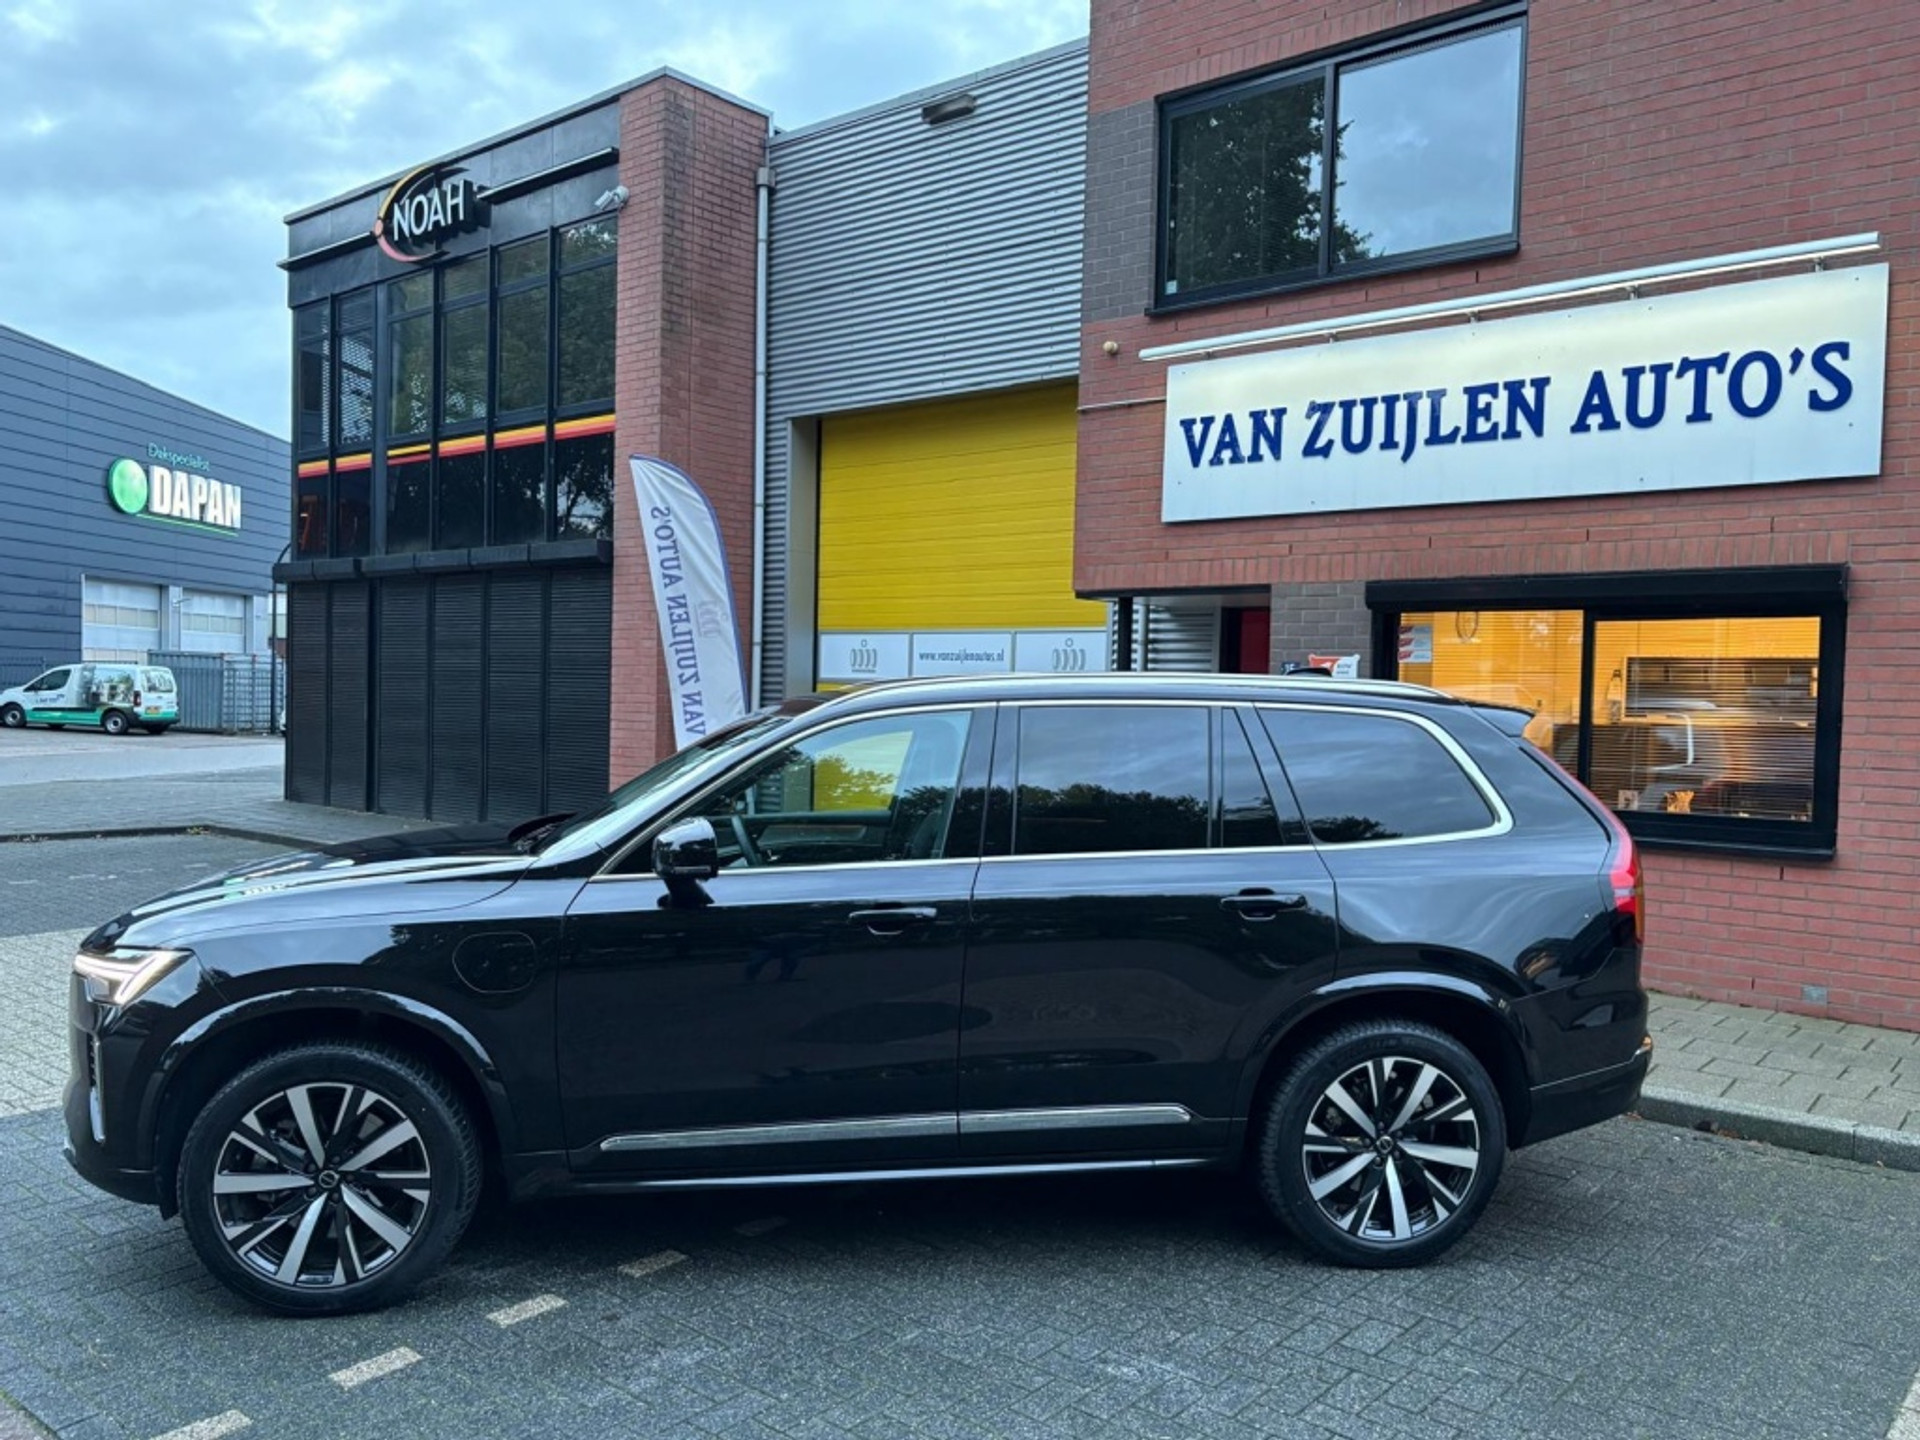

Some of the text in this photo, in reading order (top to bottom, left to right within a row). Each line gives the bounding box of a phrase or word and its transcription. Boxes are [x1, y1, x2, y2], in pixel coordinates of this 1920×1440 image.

[393, 179, 463, 241] NOAH
[1180, 341, 1853, 468] VAN ZUIJLEN AUTO'S
[149, 465, 241, 529] DAPAN
